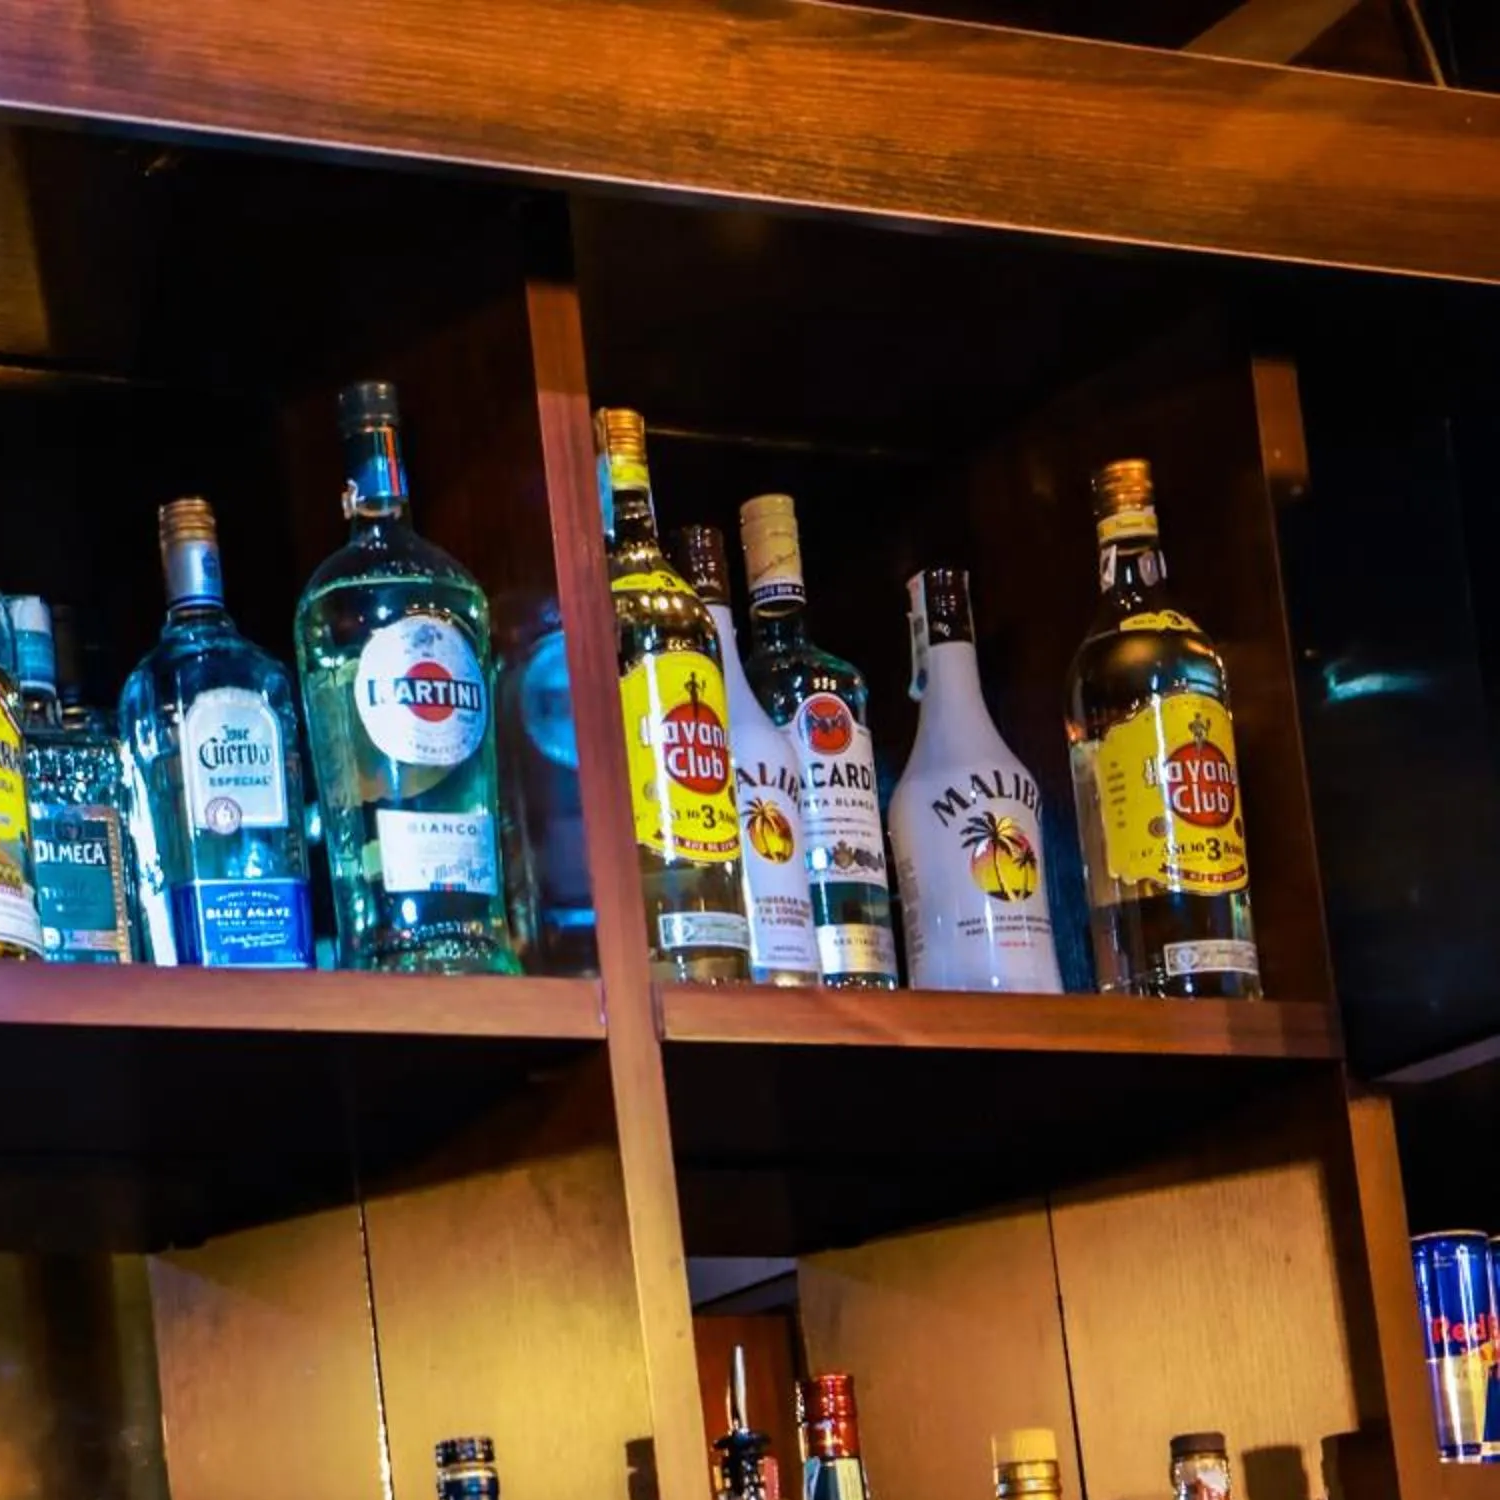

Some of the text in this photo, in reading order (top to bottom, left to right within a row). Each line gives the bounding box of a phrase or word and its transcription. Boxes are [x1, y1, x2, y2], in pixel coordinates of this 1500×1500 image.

[374, 678, 479, 710] ARTINI
[639, 715, 726, 748] avan
[667, 746, 726, 780] Club
[800, 761, 877, 793] CARD
[736, 762, 801, 813] ALIB
[1172, 783, 1230, 814] Club
